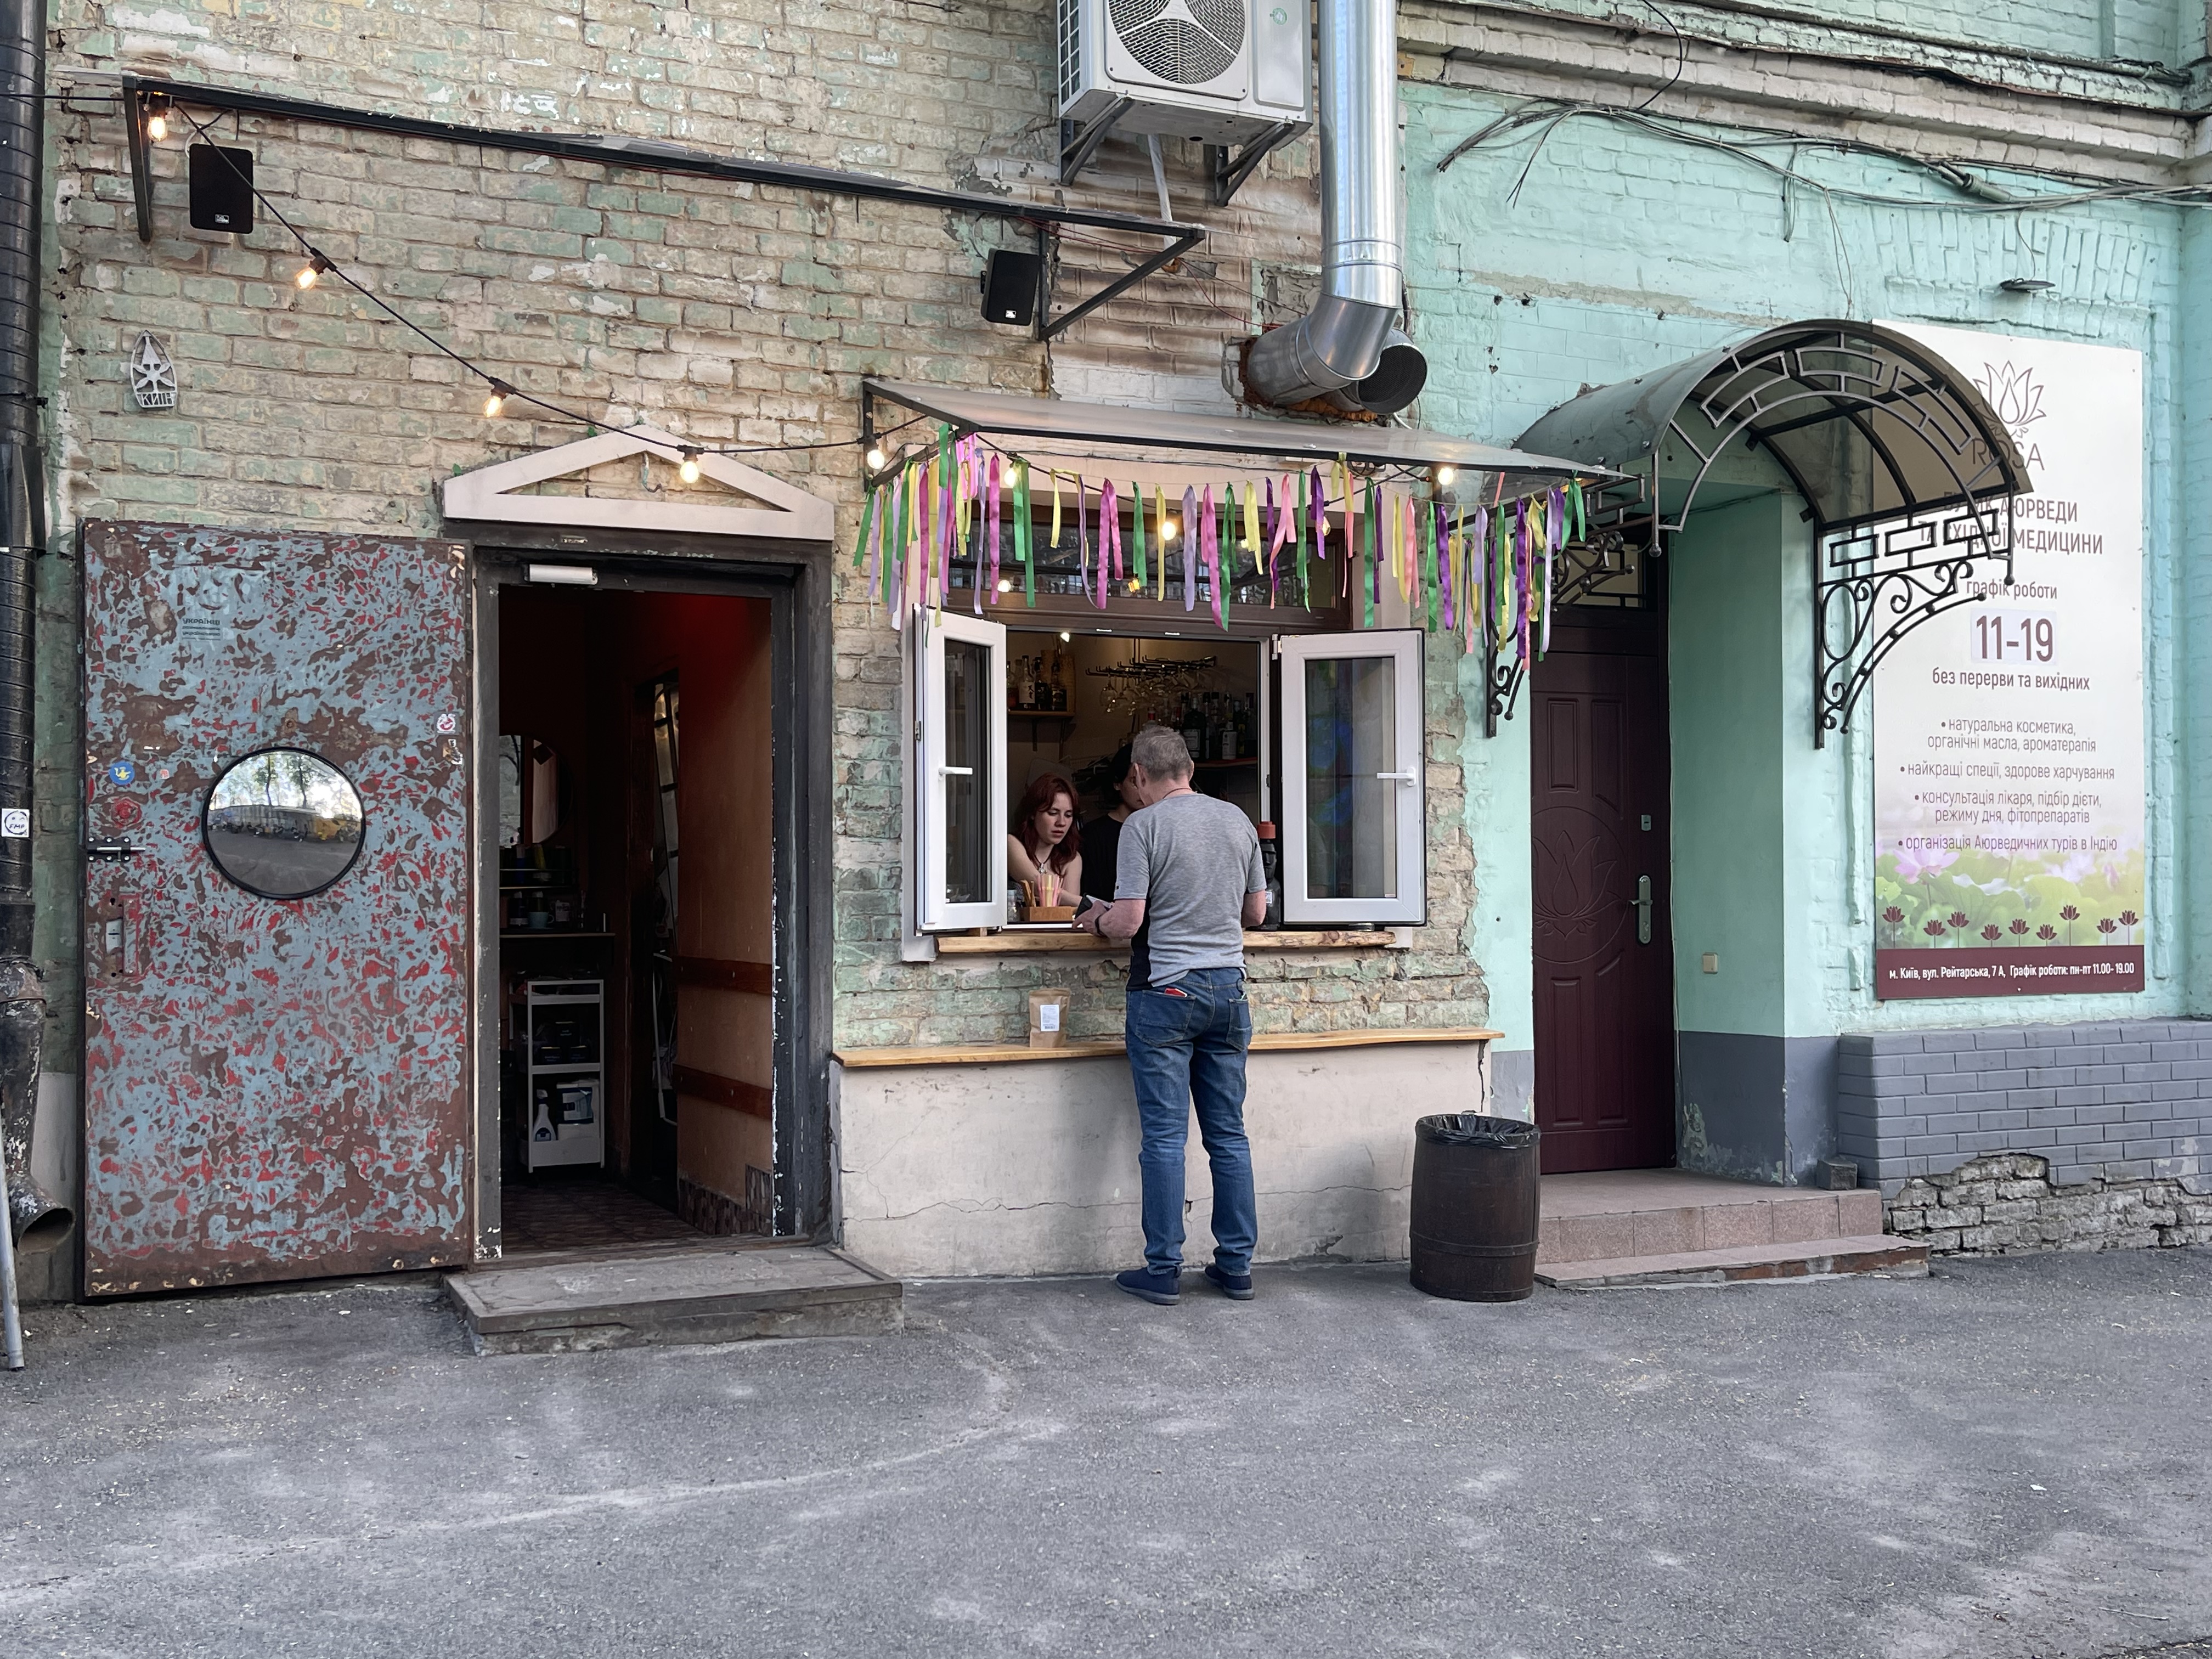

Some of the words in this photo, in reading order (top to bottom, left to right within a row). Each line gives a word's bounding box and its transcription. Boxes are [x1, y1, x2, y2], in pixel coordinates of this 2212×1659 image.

[2013, 528, 2102, 555] МЕДИЦИНИ
[1967, 578, 2010, 599] графік
[2014, 581, 2057, 600] роботи
[1976, 615, 2053, 662] 11-19
[1932, 667, 1955, 684] без
[1960, 672, 2014, 690] перерви
[2018, 674, 2031, 687] та
[2036, 672, 2090, 691] вихідних
[1949, 719, 2013, 735] натуральна
[2017, 721, 2076, 736] косметика,
[1928, 733, 1980, 749] органічні
[1984, 737, 2020, 752] масла,
[2023, 737, 2096, 753] ароматерапія
[1908, 760, 1963, 780] найкращі
[1967, 761, 2001, 779] спеції,
[2005, 765, 2050, 781] здорове
[2053, 766, 2115, 781] харчування
[1922, 789, 1994, 806] консультація
[1997, 789, 2035, 807] лікаря,
[2038, 791, 2069, 808] підбір
[2072, 791, 2102, 808] дієти,
[1936, 809, 1979, 825] режиму
[1982, 810, 2004, 824] дня,
[2007, 808, 2090, 825] фітопрепаратів
[1906, 834, 1971, 852] організація
[1974, 836, 2049, 851] Аюрведичних
[2052, 836, 2078, 853] турів
[2081, 839, 2087, 850] в
[2090, 836, 2117, 852] Індію
[1889, 969, 1898, 979] м.
[1900, 967, 1921, 980] Київ,
[1922, 969, 1939, 980] вул.
[1941, 966, 1991, 979] Рейтарська,
[1991, 966, 1997, 977] 7
[1999, 966, 2006, 978] А,
[2010, 964, 2037, 978] Графік
[2039, 964, 2068, 978] роботи:
[2070, 965, 2092, 975] пн-пт
[2115, 962, 2135, 974] 19.00
